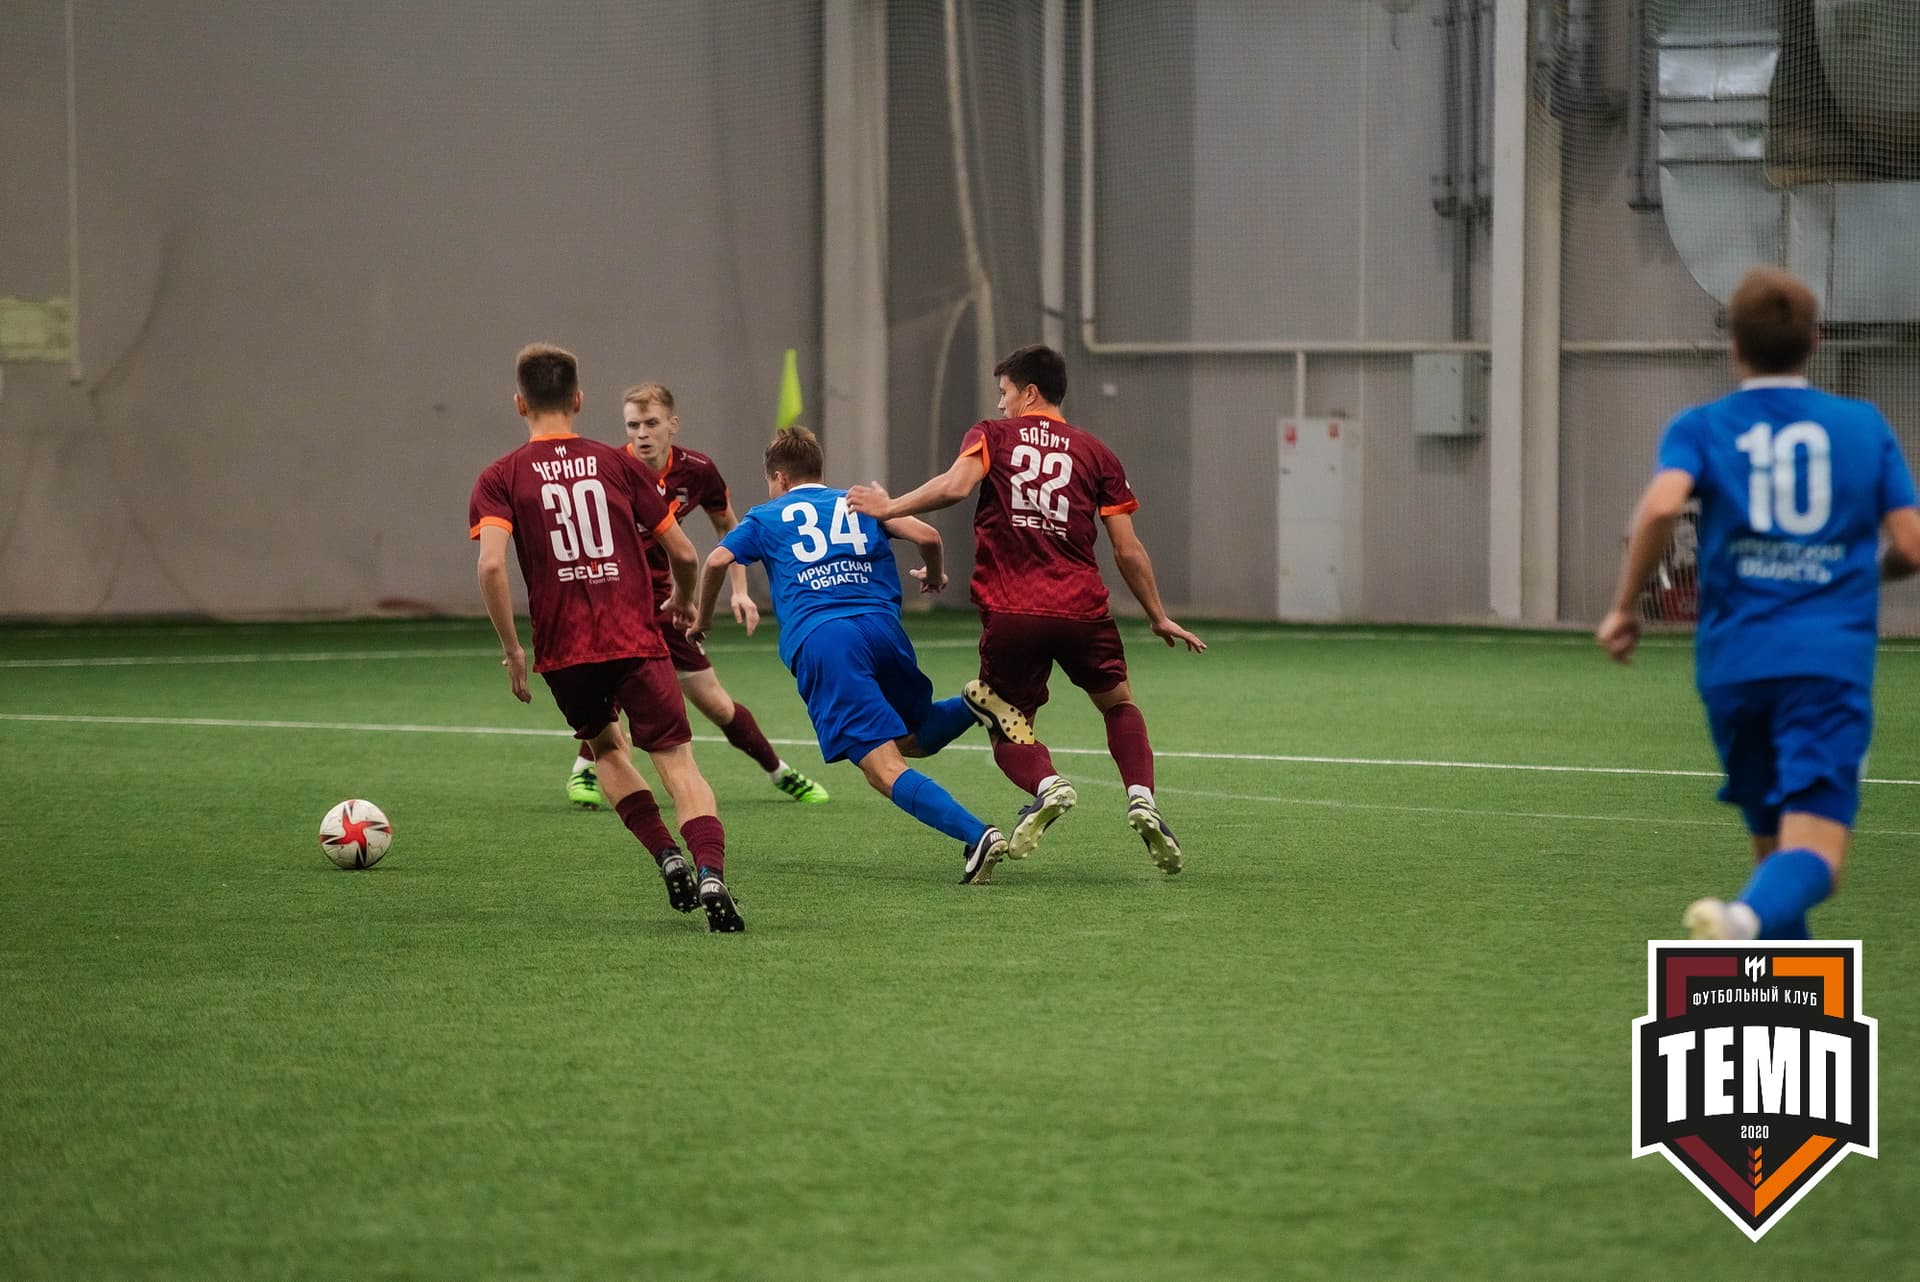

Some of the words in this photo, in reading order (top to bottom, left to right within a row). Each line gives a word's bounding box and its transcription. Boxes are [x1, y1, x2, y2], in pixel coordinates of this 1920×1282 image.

[1019, 427, 1071, 451] БАБИЧ
[532, 456, 598, 481] ЧЕРНОВ
[1735, 420, 1832, 535] 10
[1010, 444, 1073, 523] 22
[541, 478, 614, 562] 30
[781, 496, 868, 563] 34
[557, 561, 620, 582] SEUS
[796, 560, 873, 584] ИРКУТСКАЯ
[810, 573, 869, 591] ОБЛАСТЬ
